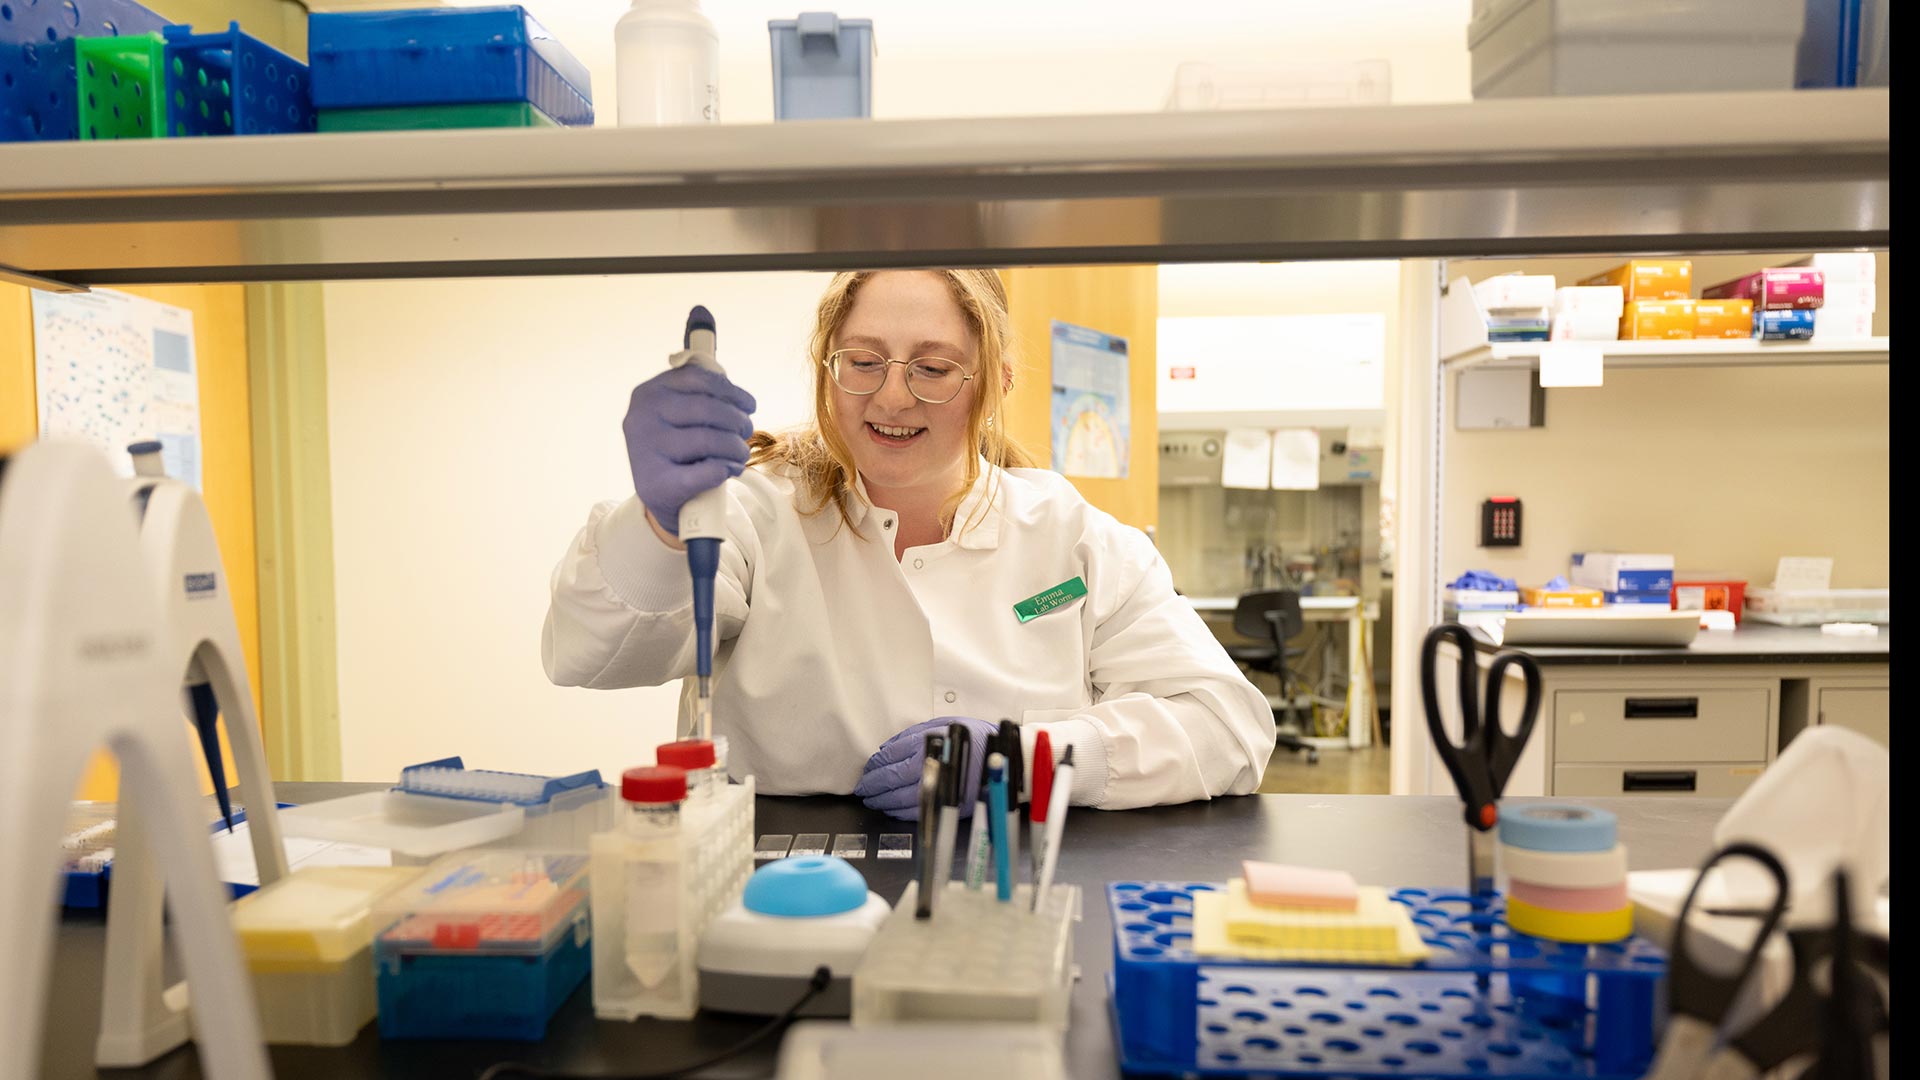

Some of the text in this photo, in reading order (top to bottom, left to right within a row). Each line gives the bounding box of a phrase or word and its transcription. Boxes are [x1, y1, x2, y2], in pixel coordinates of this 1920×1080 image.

[1034, 589, 1064, 606] Emma
[1034, 593, 1073, 615] Lab Worm
